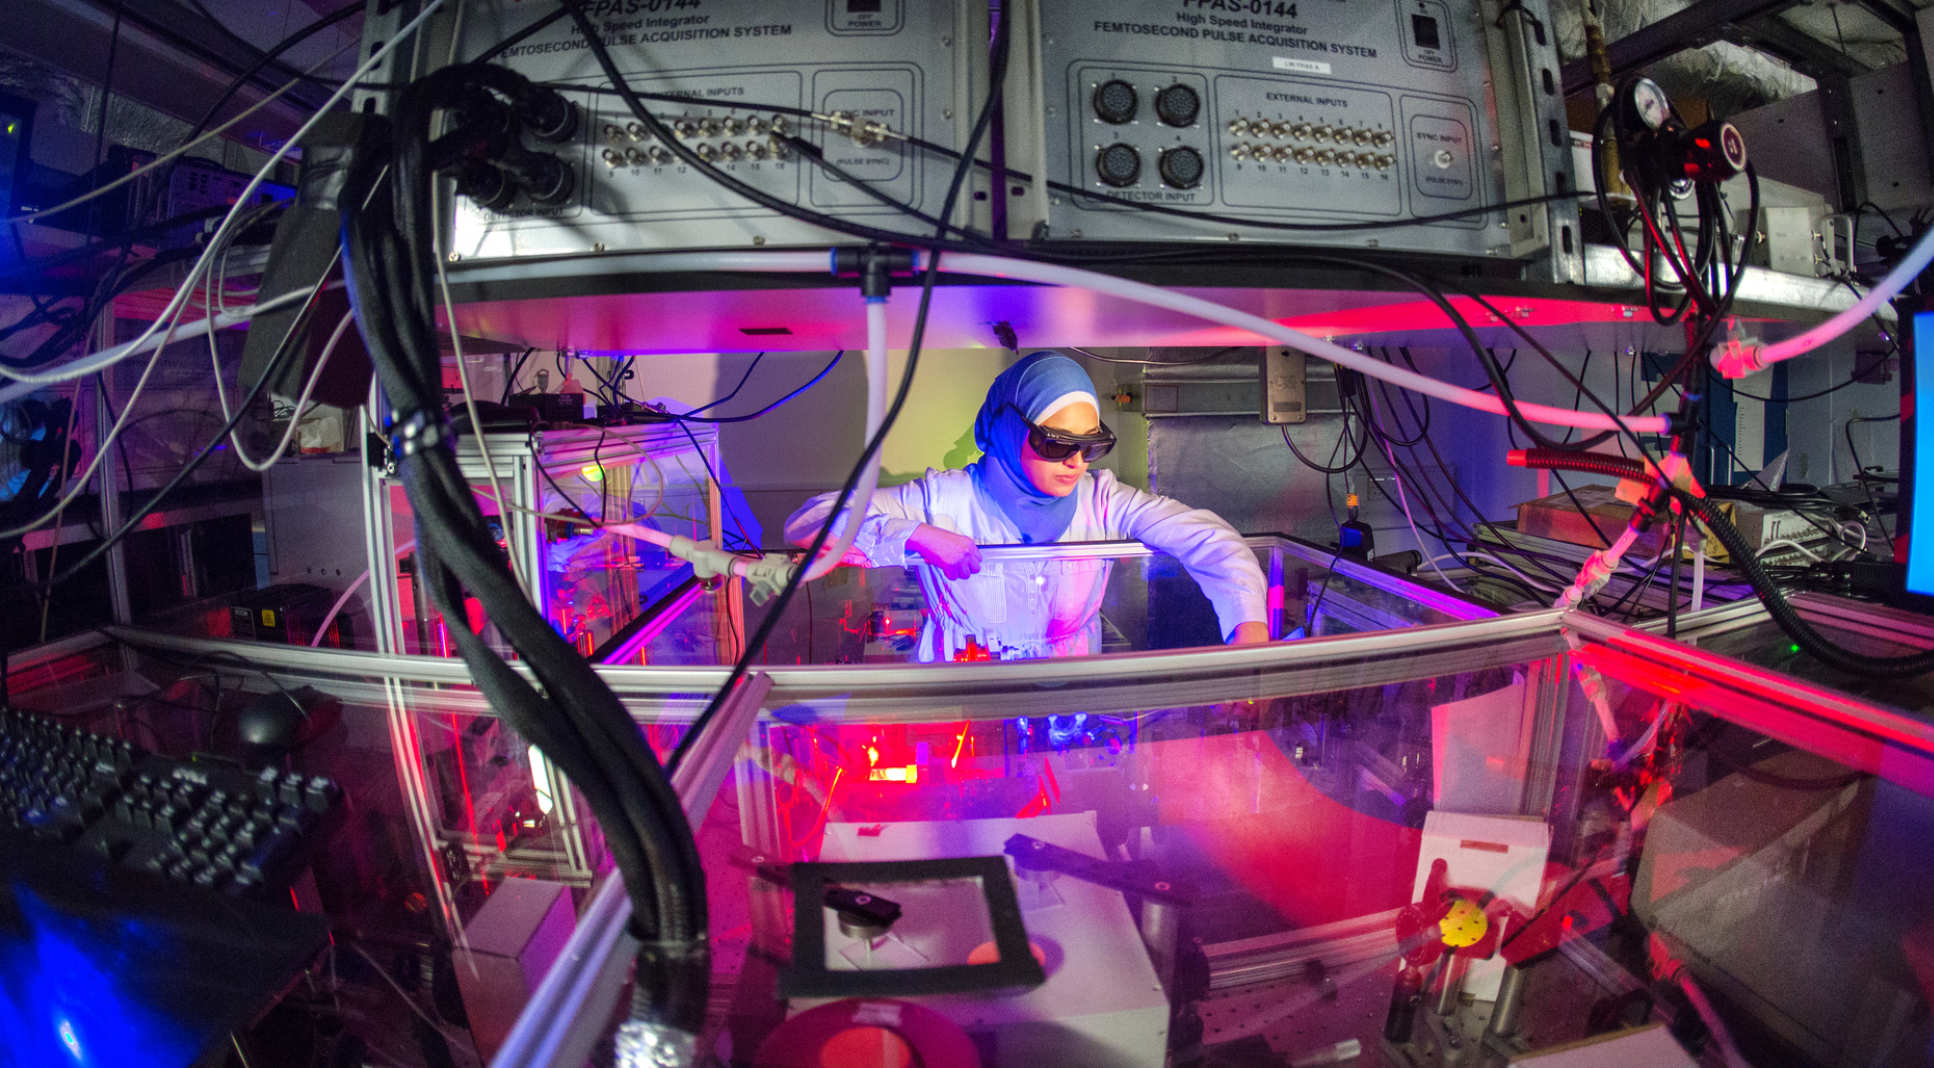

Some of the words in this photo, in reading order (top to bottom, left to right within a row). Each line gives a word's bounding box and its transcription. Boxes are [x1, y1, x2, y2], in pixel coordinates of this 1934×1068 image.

[571, 23, 599, 35] Hih
[602, 19, 642, 33] Speed
[645, 15, 710, 30] Integrator
[1177, 11, 1206, 25] High
[1209, 15, 1247, 28] Speed
[1250, 19, 1308, 35] Integrator
[499, 39, 593, 58] EMTOSECOND
[602, 34, 637, 48] ULSE
[640, 27, 730, 43] ACQUISITION
[733, 24, 792, 37] SYSTEM
[1094, 21, 1198, 39] FEMTOSECOND
[1202, 29, 1245, 43] PULSE
[1249, 33, 1328, 52] ACQUISITION
[1330, 43, 1378, 58] SYSTEM
[1266, 92, 1313, 105] EXTERNAL
[1315, 97, 1348, 108] INPUTS
[1165, 192, 1195, 202] INPUT
